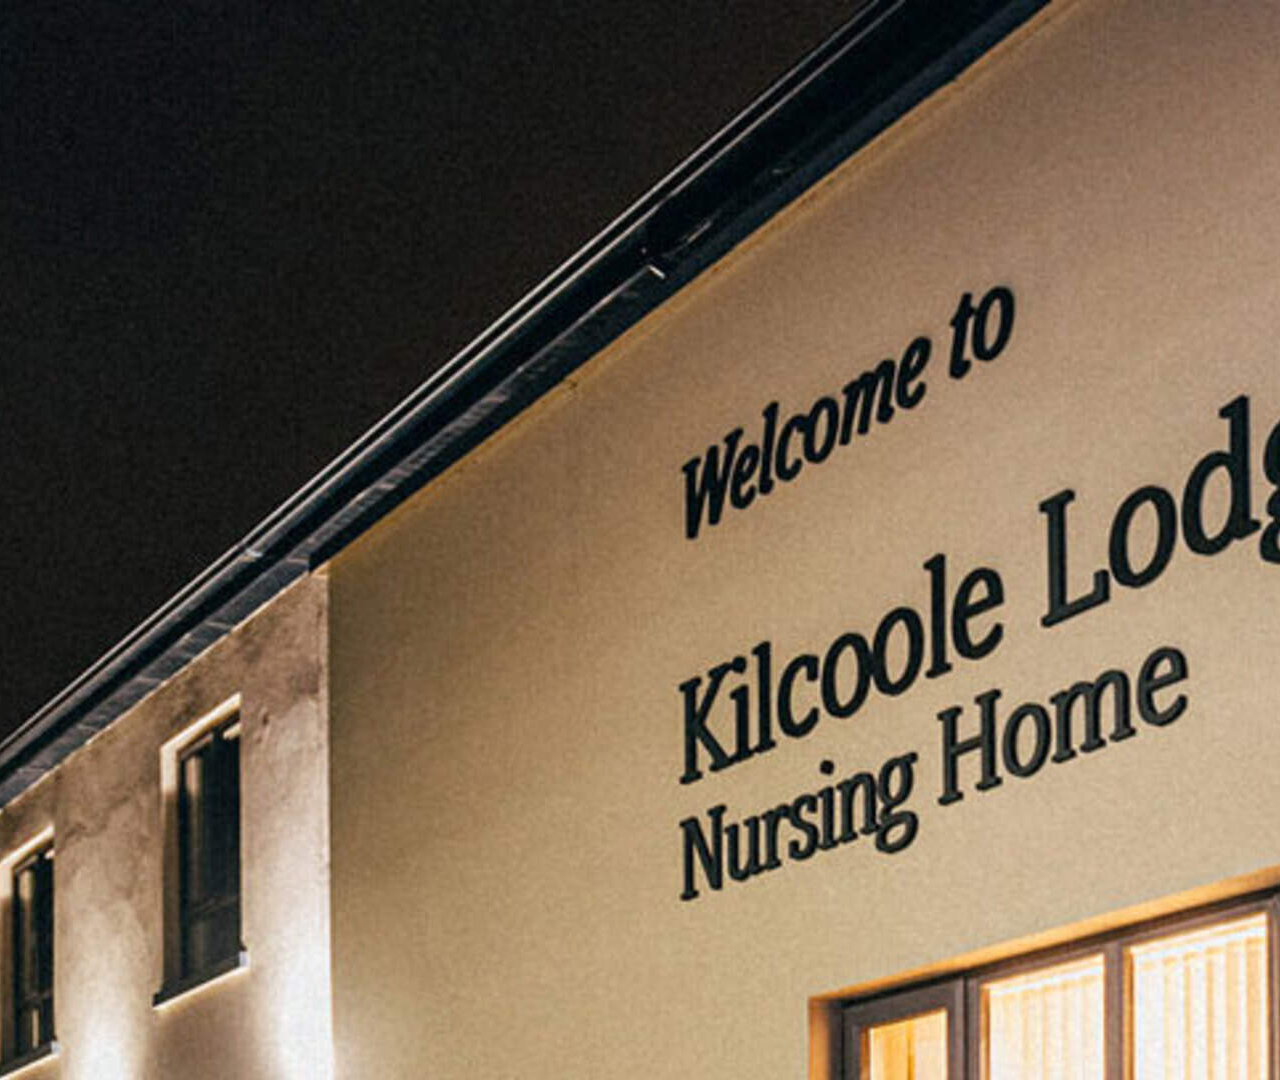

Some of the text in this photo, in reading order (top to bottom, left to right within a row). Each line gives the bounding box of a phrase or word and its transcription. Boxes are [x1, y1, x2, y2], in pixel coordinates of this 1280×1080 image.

[680, 285, 1016, 541] Welcome to
[678, 553, 1006, 786] Kilcoole
[678, 646, 1189, 902] Nursing Home
